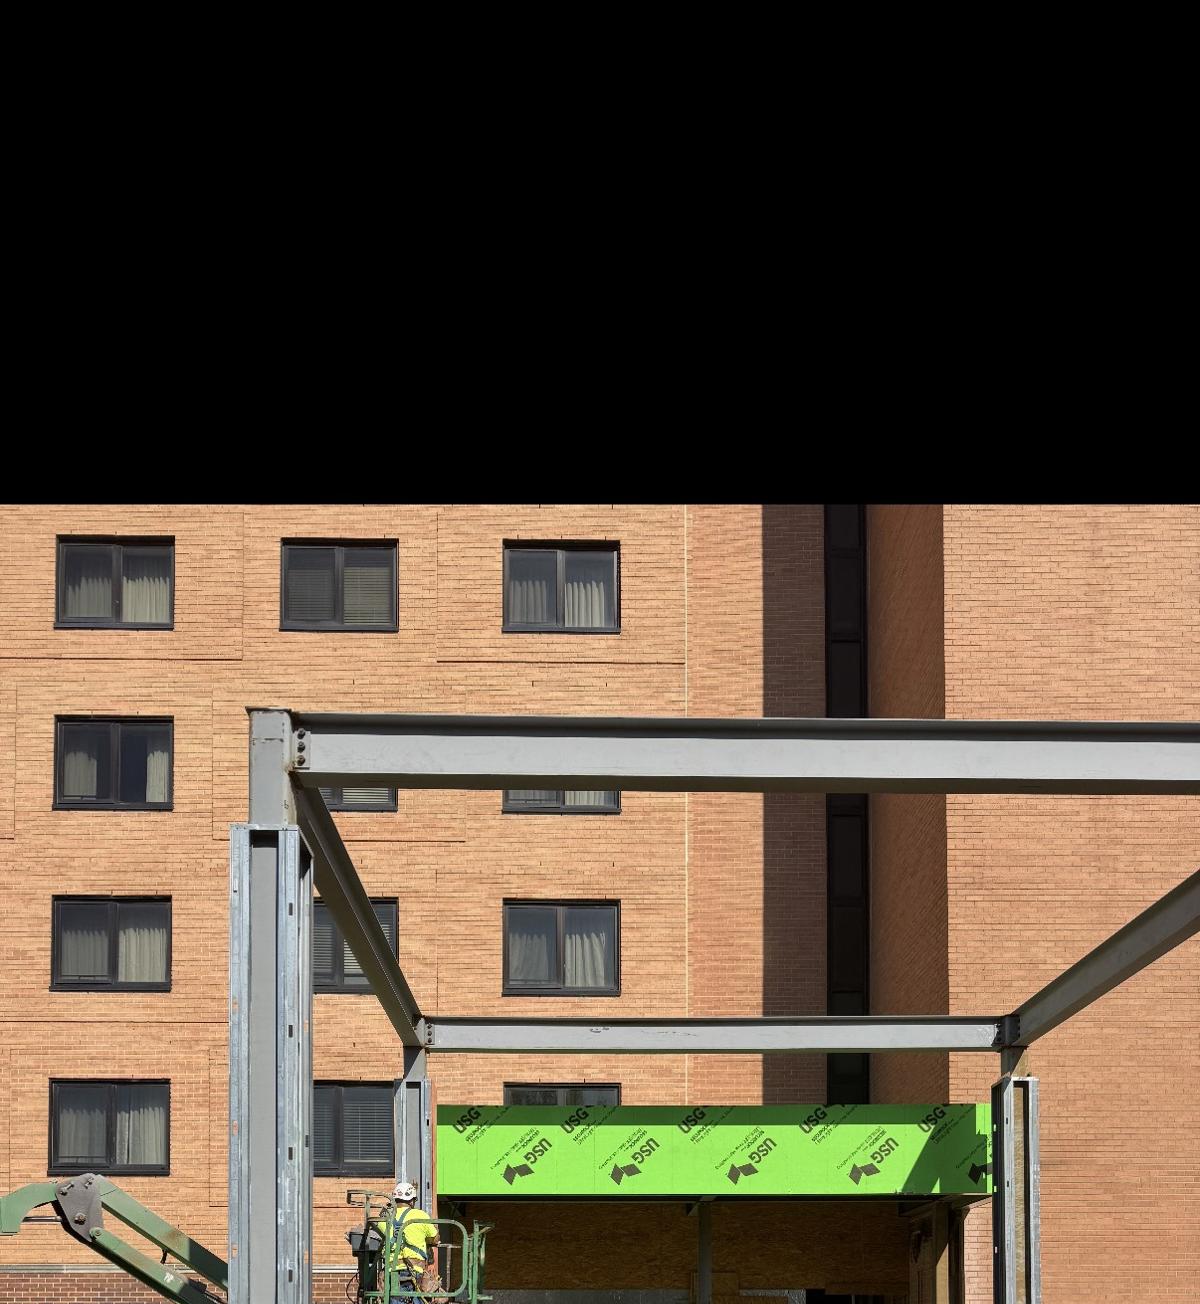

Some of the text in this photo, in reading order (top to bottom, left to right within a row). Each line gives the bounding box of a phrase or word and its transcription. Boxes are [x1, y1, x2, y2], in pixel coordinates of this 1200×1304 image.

[452, 1107, 481, 1134] USG
[559, 1107, 589, 1134] USG
[677, 1107, 706, 1134] USG
[799, 1107, 828, 1134] USG
[917, 1106, 947, 1133] USG
[523, 1137, 553, 1165] USG
[631, 1137, 661, 1165] USG
[748, 1137, 777, 1165] USG
[870, 1136, 899, 1164] USG
